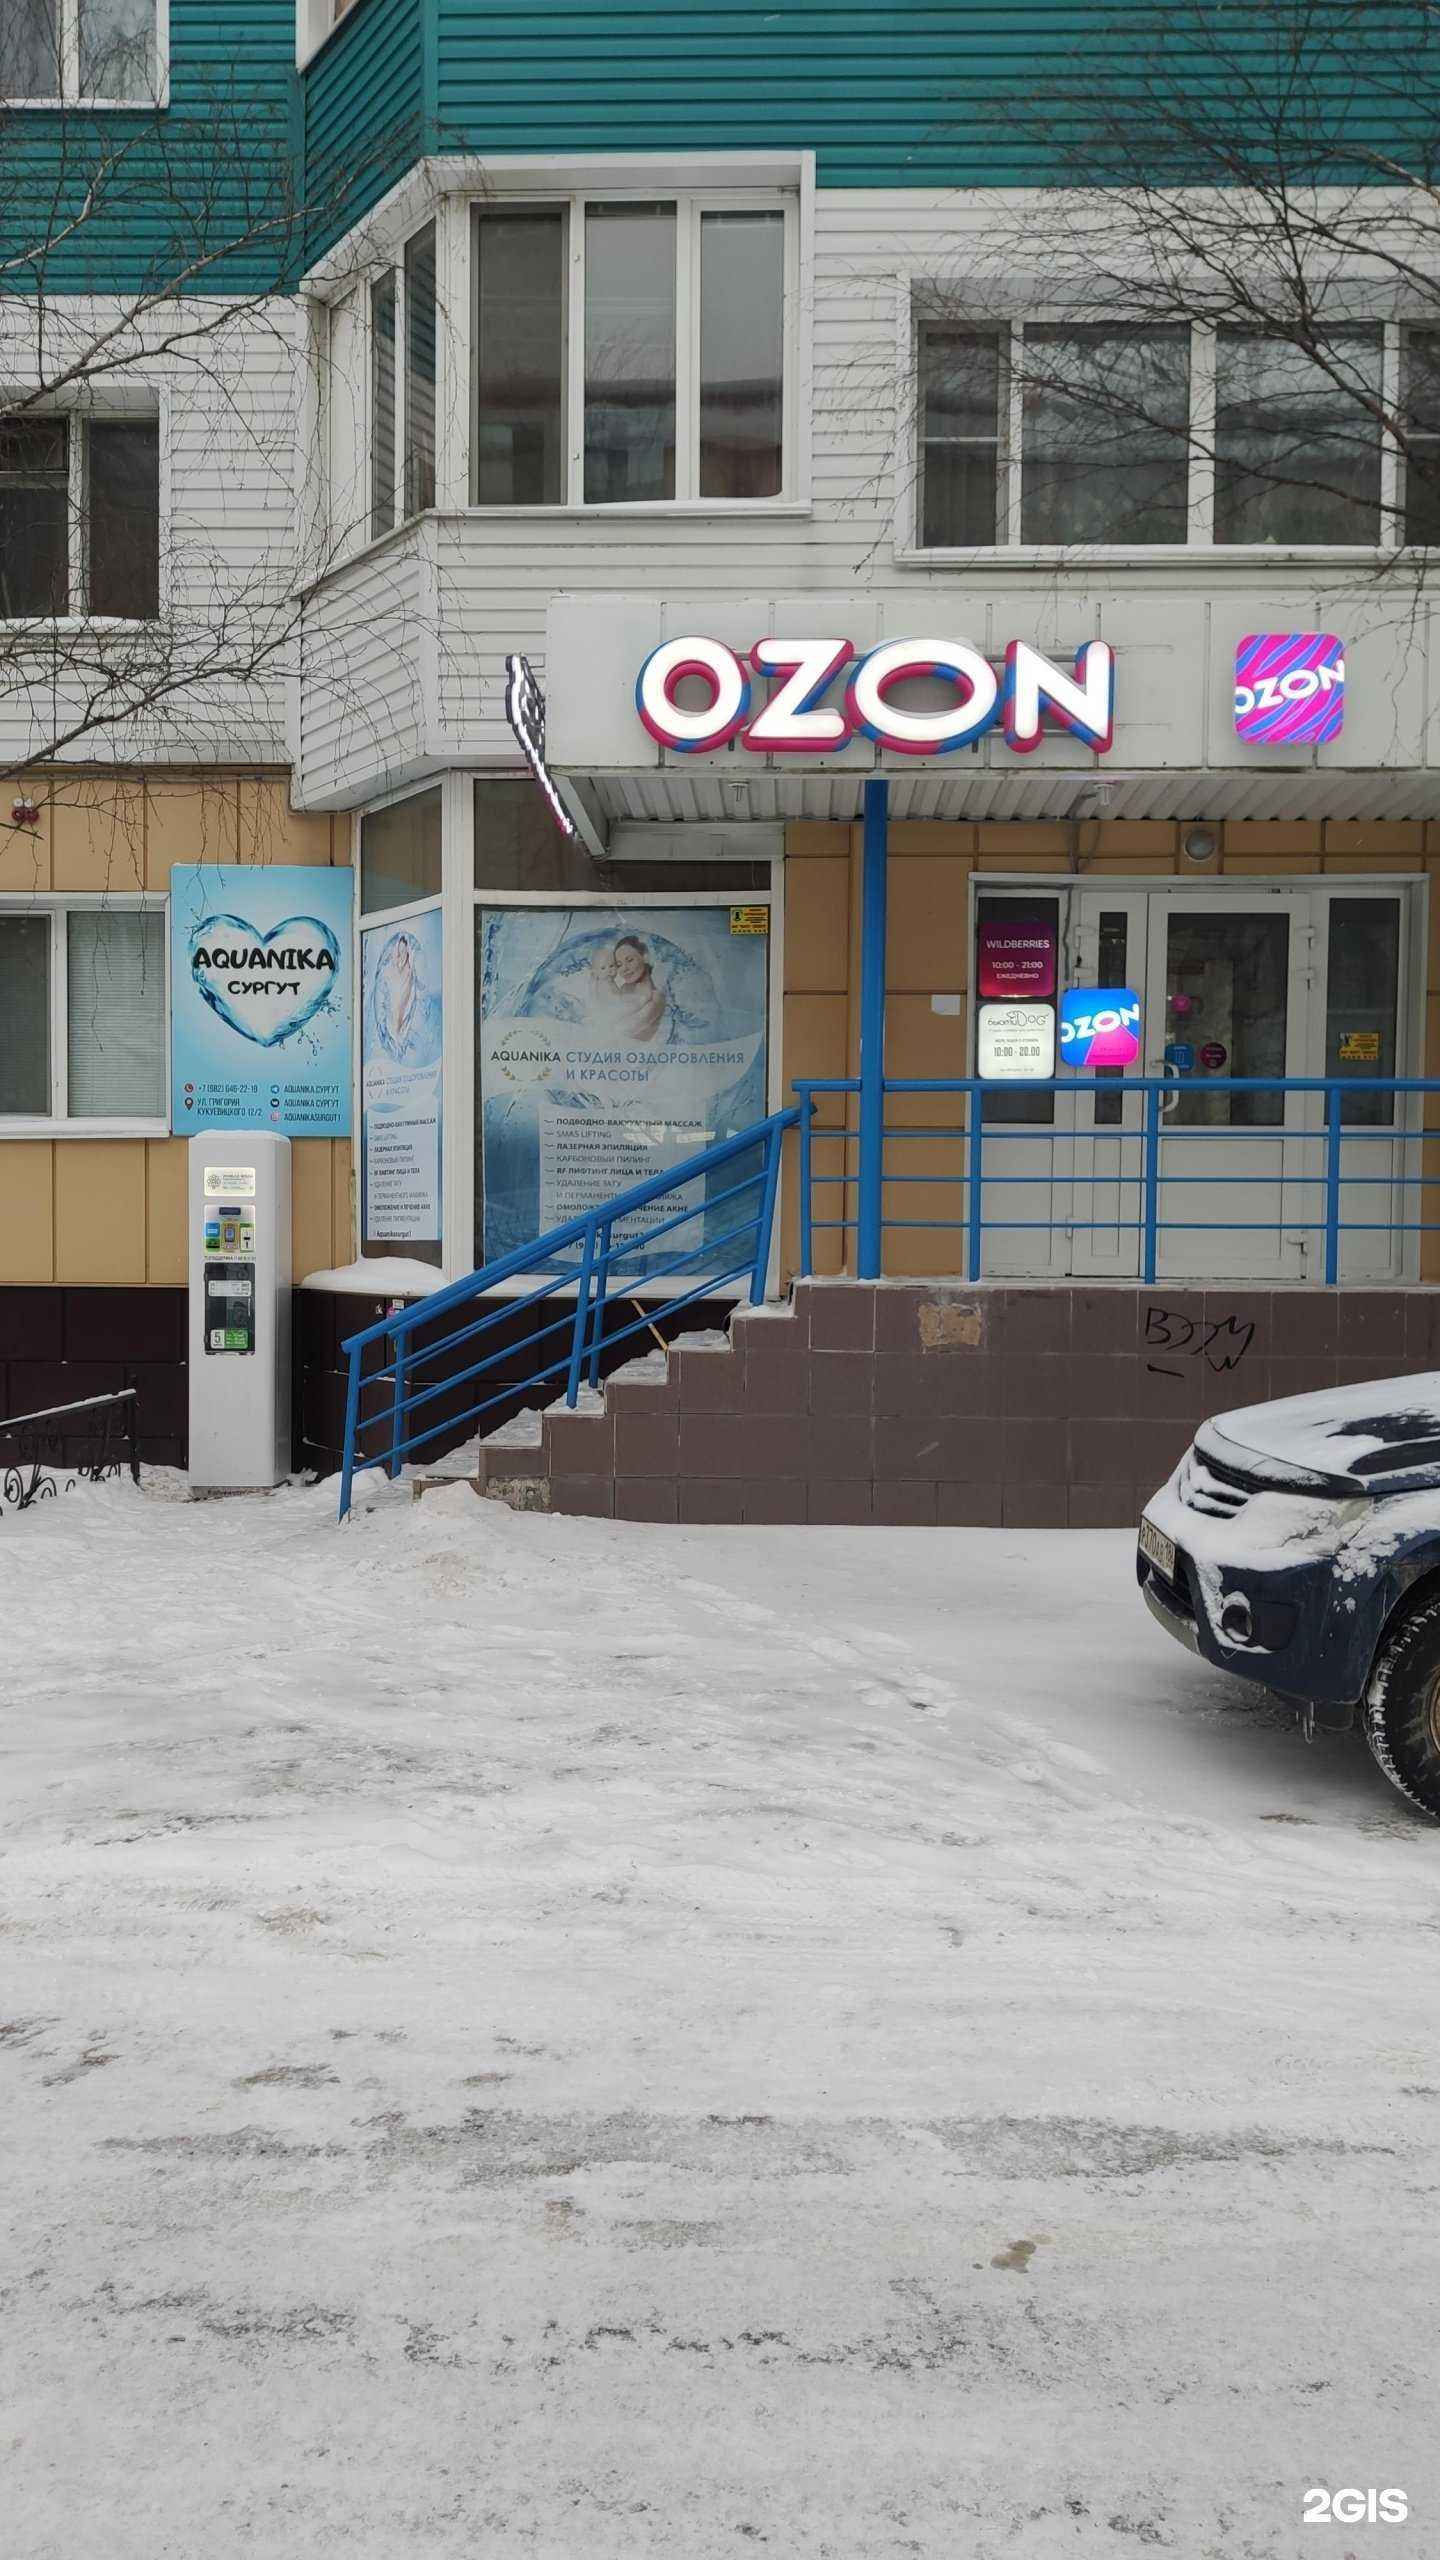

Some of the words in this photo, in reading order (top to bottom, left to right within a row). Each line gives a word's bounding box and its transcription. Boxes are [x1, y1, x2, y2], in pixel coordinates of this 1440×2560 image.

[1234, 659, 1345, 714] OZON
[636, 635, 1115, 753] OZON
[986, 939, 1050, 949] WILDBERRIES
[193, 948, 335, 970] AQUANIKA
[992, 961, 1014, 969] 10:00
[1021, 961, 1044, 969] 21:00
[227, 980, 301, 995] СУРГУТ
[1061, 1003, 1140, 1043] OZON
[490, 1050, 561, 1063] AQUANIKA
[566, 1051, 621, 1064] СТУДИЯ
[626, 1052, 744, 1064] ОЗДОРОВЛЕНИЯ
[566, 1069, 576, 1080] И
[580, 1069, 649, 1081] КРАСОТЫ
[664, 1119, 702, 1128] МАССАЖ
[556, 1143, 600, 1151] ЛАЗЕРНАЯ
[601, 1144, 648, 1152] ЭПИЛЯЦИЯ
[609, 1169, 634, 1177] ЛИЦА
